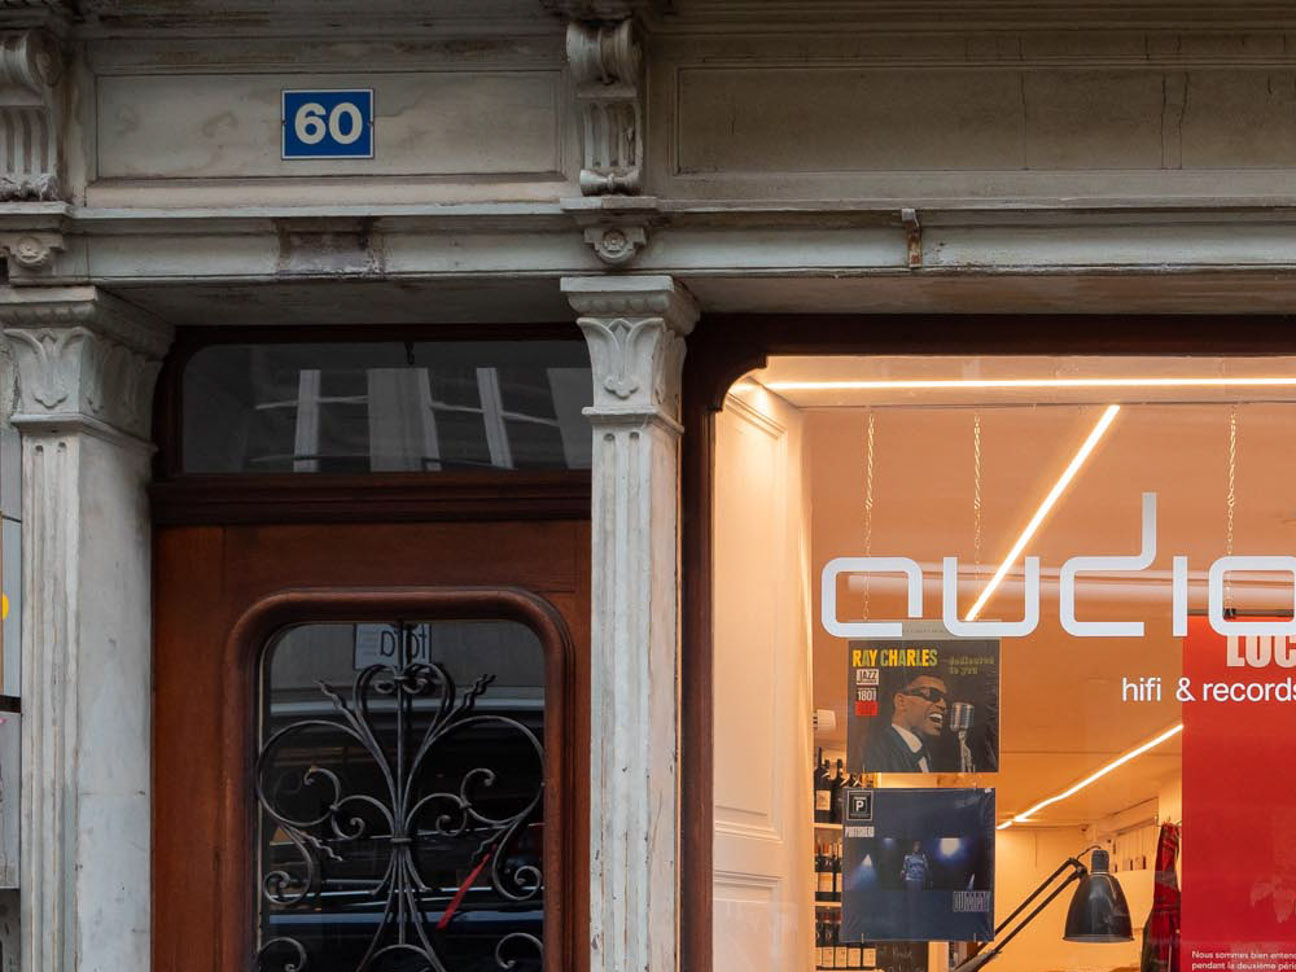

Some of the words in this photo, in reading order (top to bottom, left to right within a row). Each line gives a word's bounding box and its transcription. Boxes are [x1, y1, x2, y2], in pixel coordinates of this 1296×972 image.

[295, 102, 363, 145] 60
[852, 649, 878, 667] RAY
[880, 649, 938, 667] CHARLES
[1122, 677, 1162, 702] hifi
[1175, 677, 1195, 702] &
[1192, 951, 1214, 959] Nous
[1250, 951, 1268, 959] bien
[1192, 961, 1225, 971] pendant
[1236, 961, 1276, 969] deuxième
